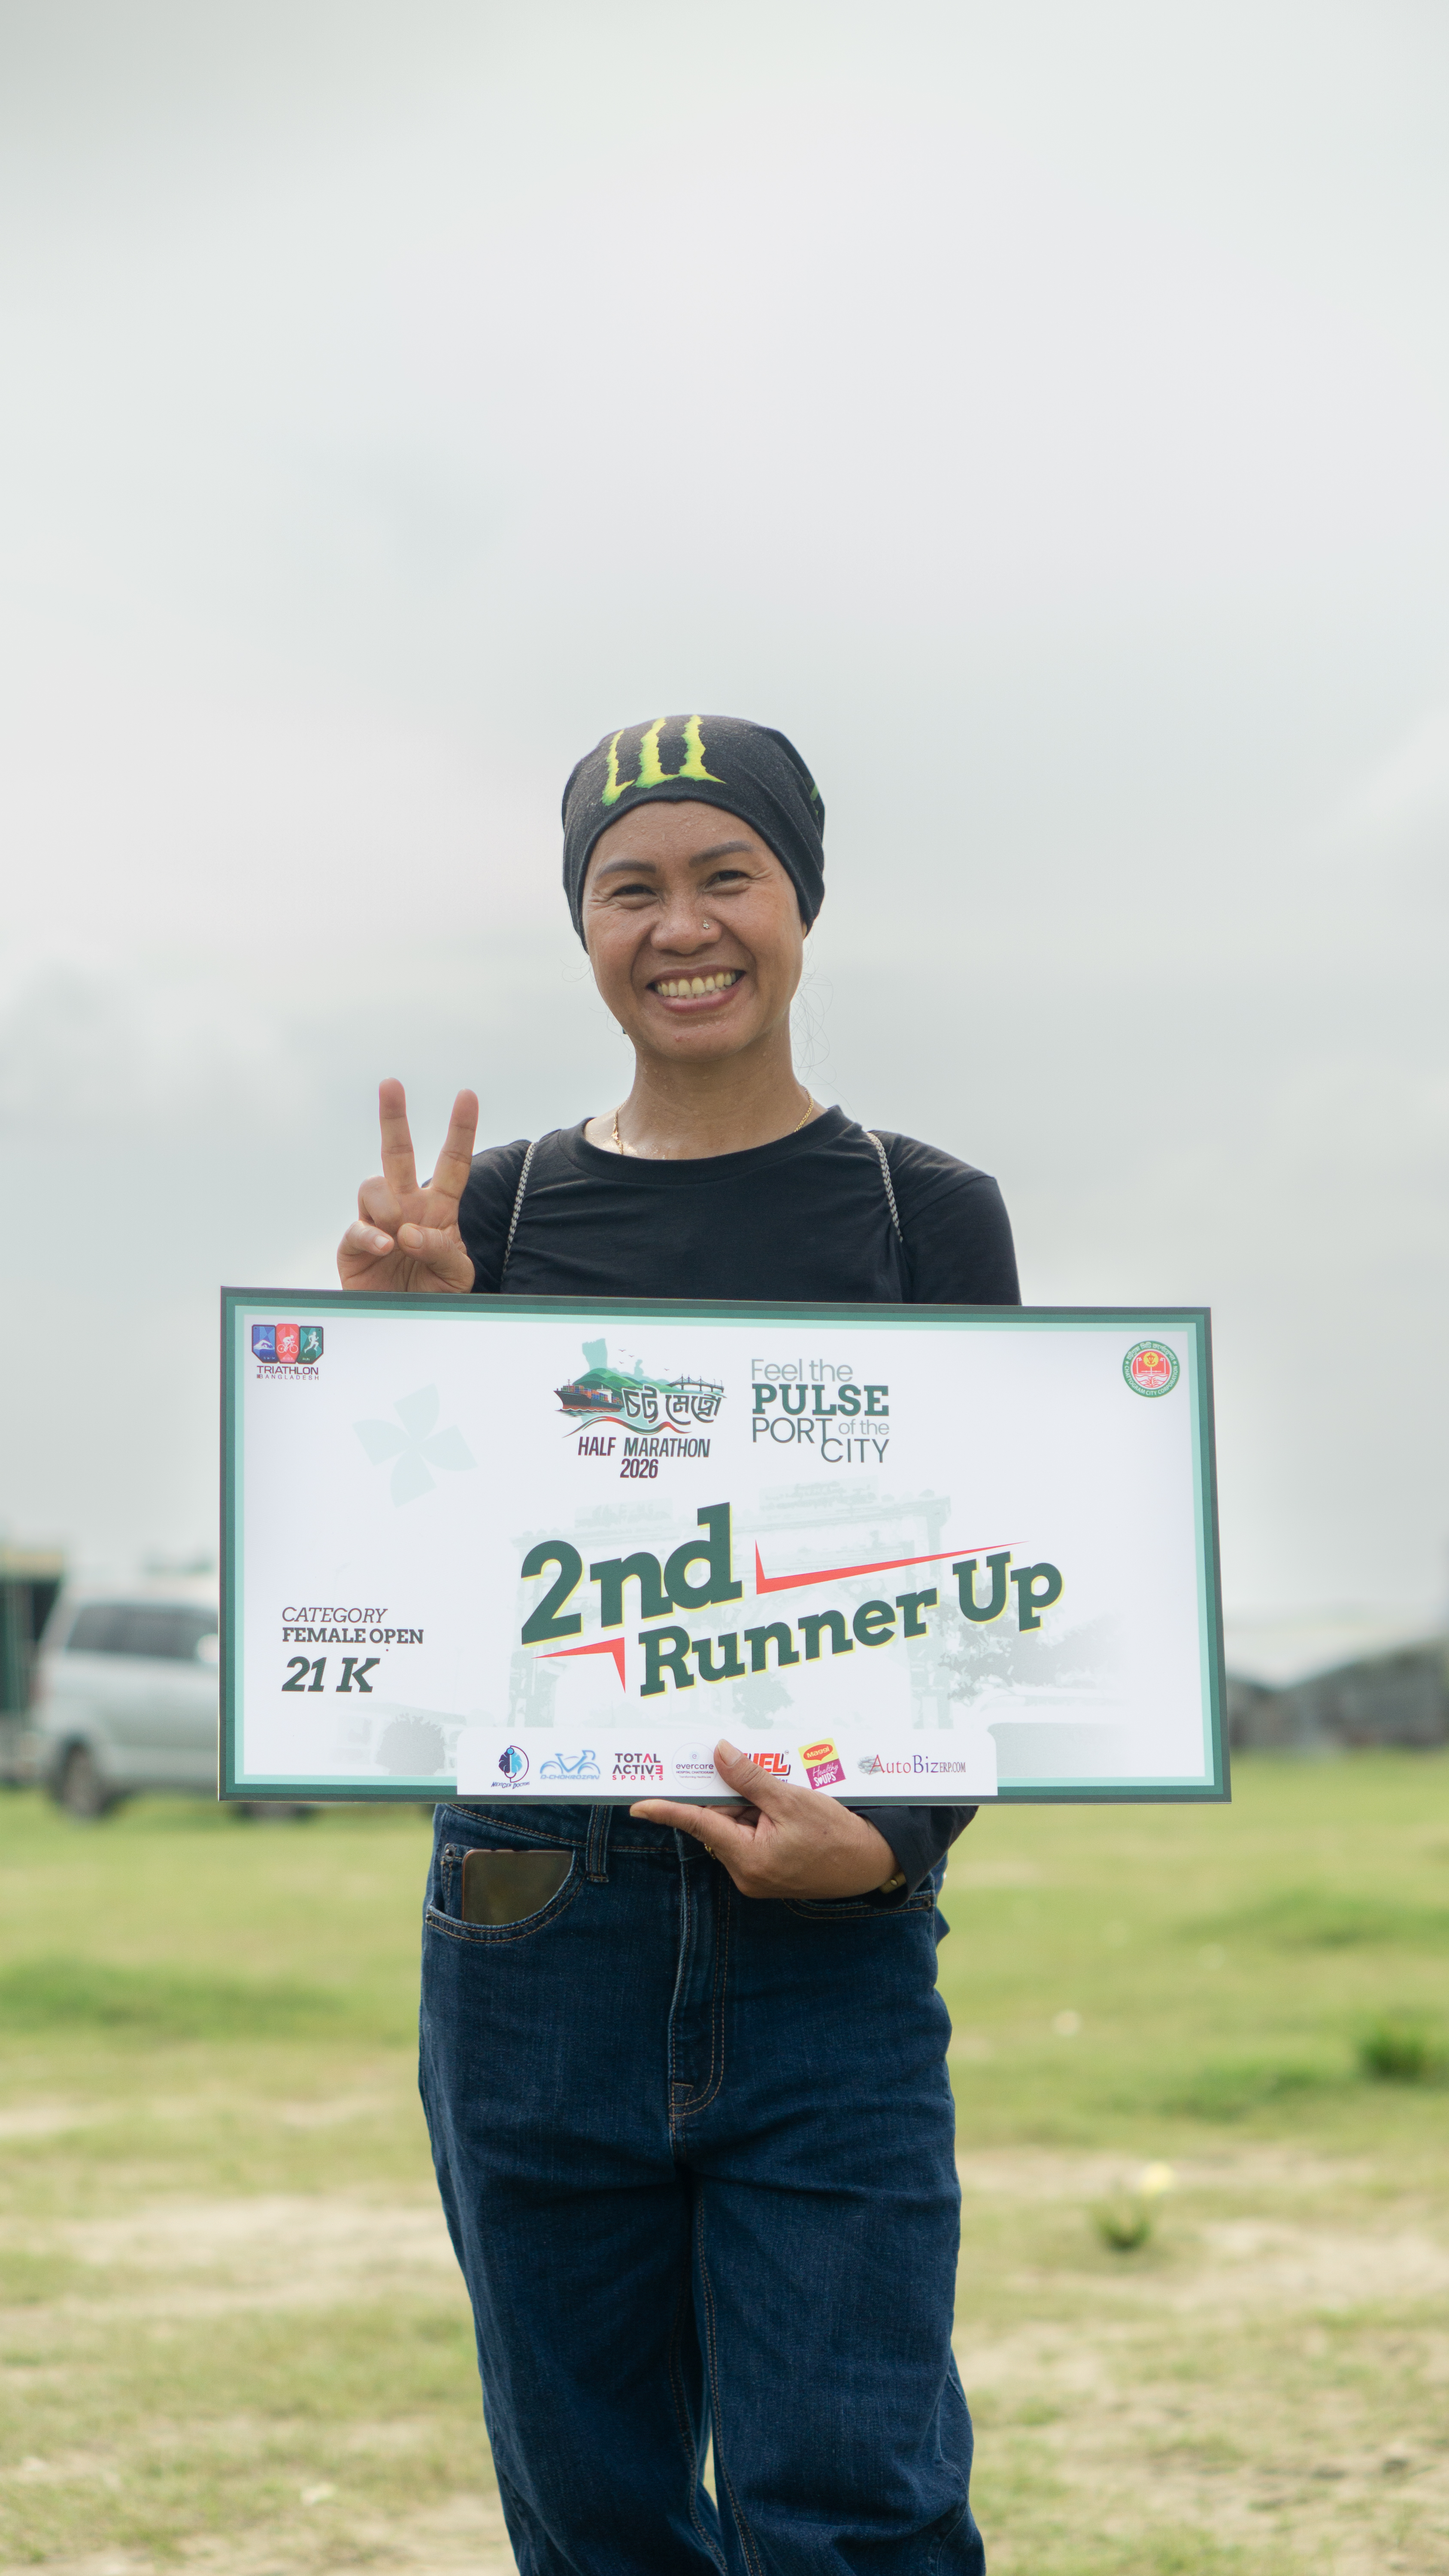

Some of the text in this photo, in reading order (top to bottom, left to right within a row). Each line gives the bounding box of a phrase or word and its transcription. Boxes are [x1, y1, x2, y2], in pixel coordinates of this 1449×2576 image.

[257, 1365, 318, 1375] TRIATHLON
[752, 1358, 853, 1382] Feel the
[1125, 1365, 1146, 1394] CHATTOGRAM
[1158, 1365, 1178, 1394] CORPORATION
[752, 1383, 889, 1417] PULSE
[752, 1417, 890, 1444] PORT of the
[578, 1436, 711, 1458] HALF MARATHON
[821, 1438, 890, 1463] CITY
[620, 1458, 659, 1479] 2026
[520, 1501, 743, 1647] 2nd
[282, 1607, 388, 1623] CATEGORY
[637, 1551, 1064, 1698] Runner Up
[282, 1627, 424, 1644] FEMALE OPEN
[281, 1656, 381, 1693] 21 K
[615, 1753, 661, 1763] TOTAL
[806, 1746, 831, 1758] Maggi
[612, 1764, 663, 1774] ACTIVE
[813, 1762, 839, 1777] Healthy
